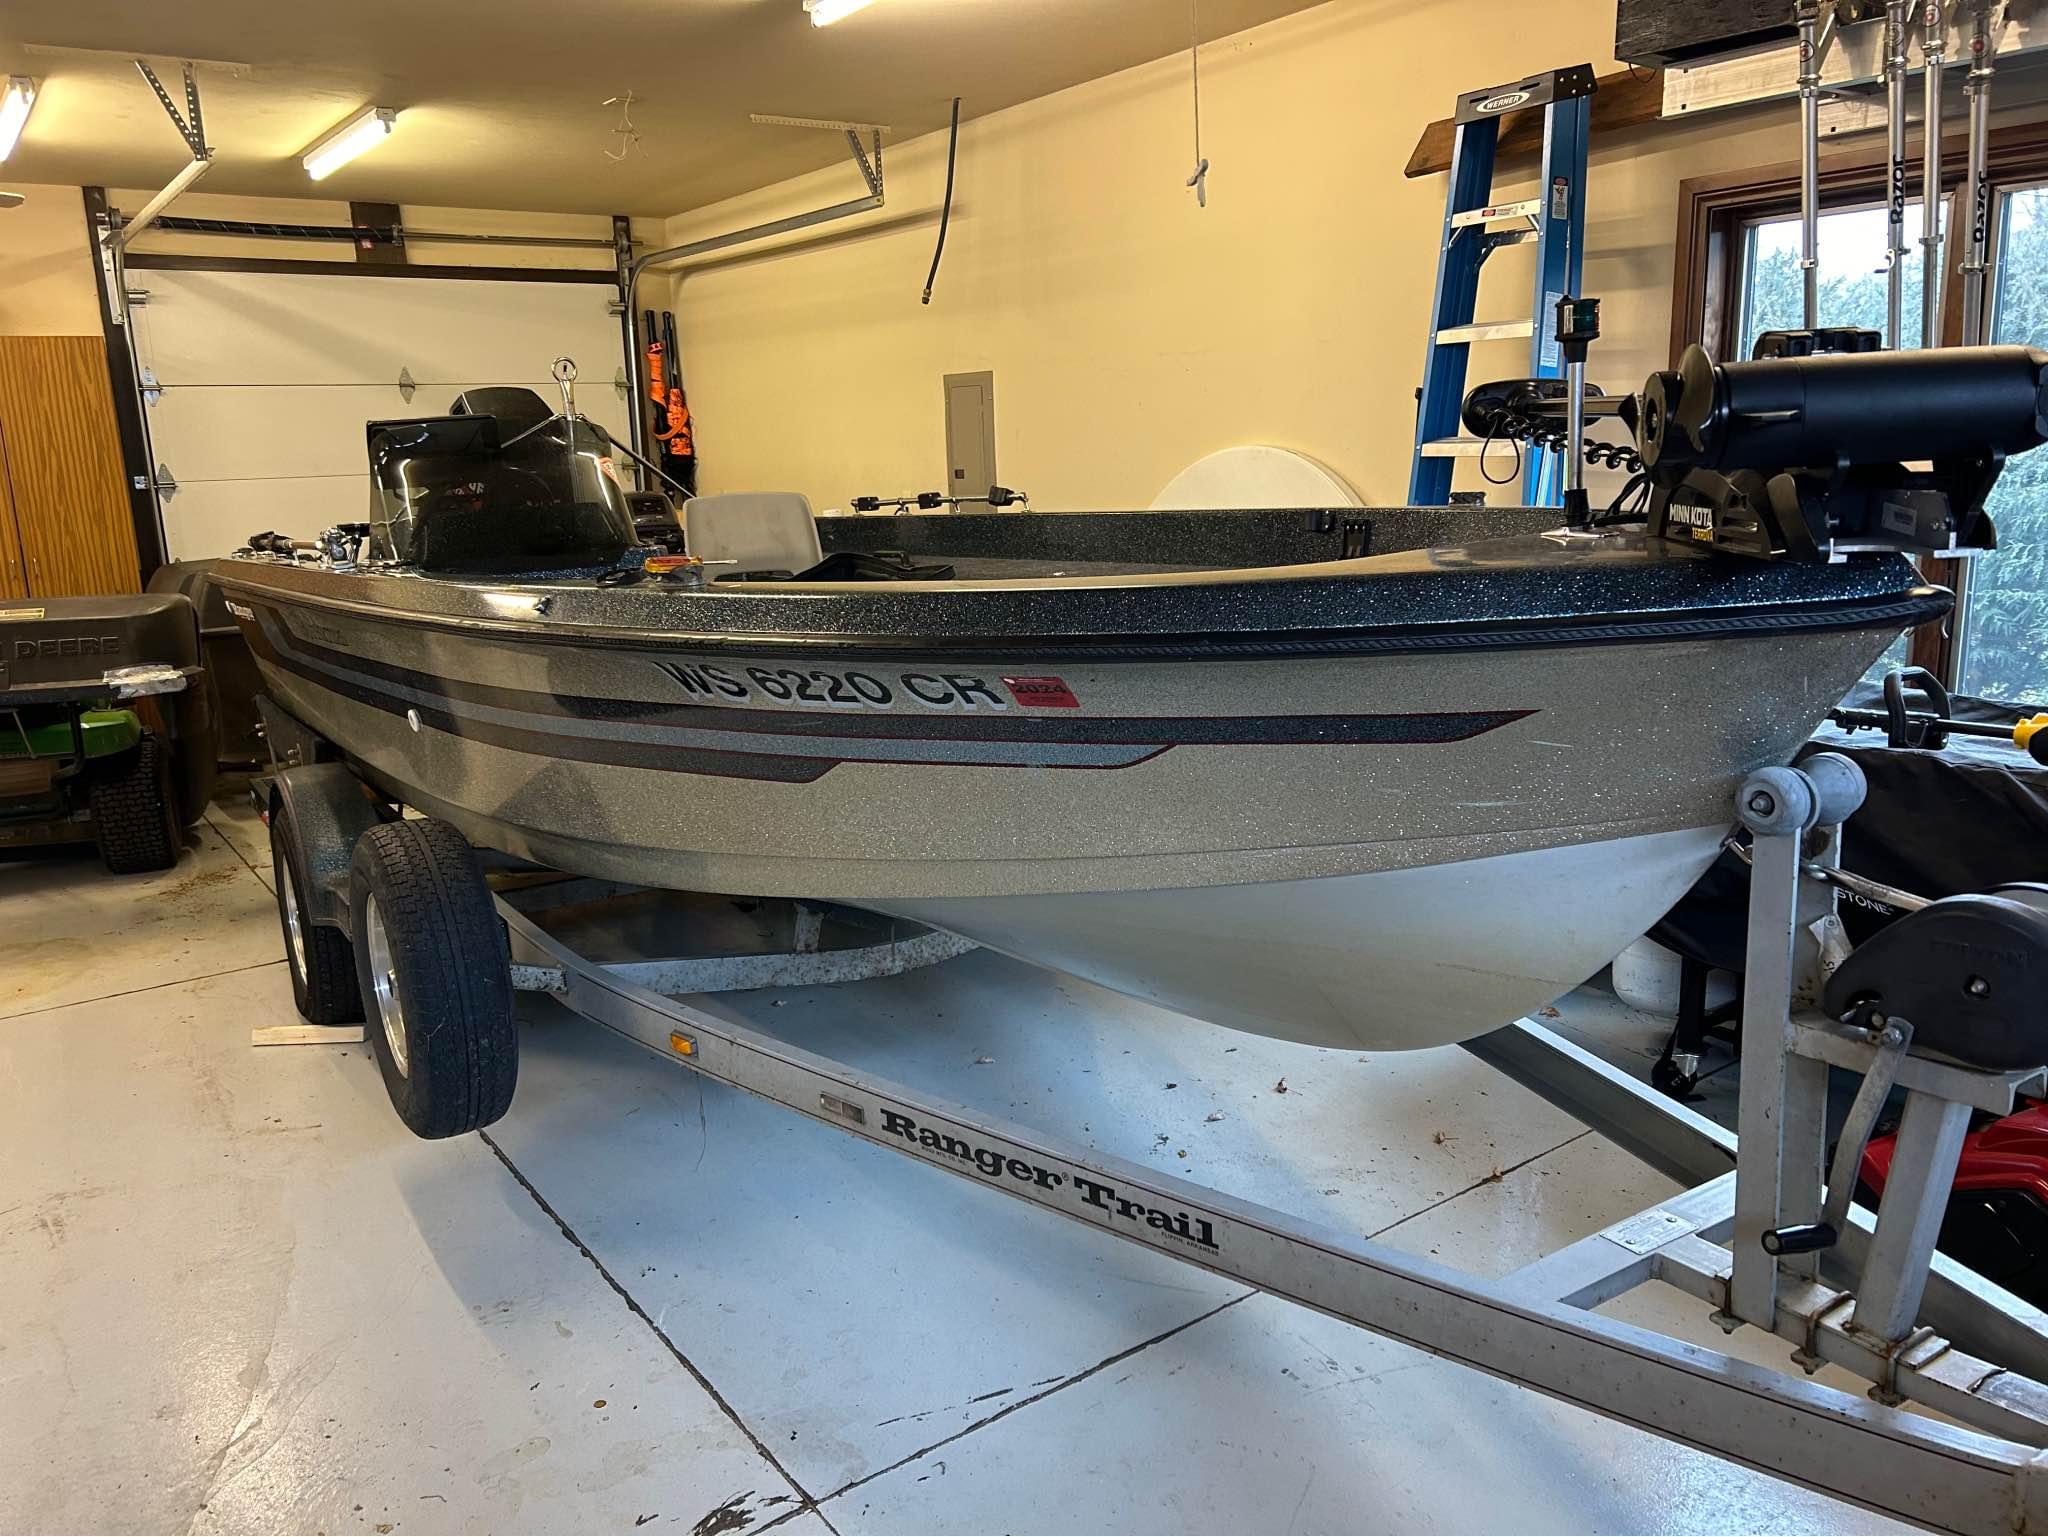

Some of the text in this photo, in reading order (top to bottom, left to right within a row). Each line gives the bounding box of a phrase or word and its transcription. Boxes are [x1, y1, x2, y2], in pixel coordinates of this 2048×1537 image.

[1486, 95, 1520, 109] WERNER
[1891, 154, 1905, 225] Razor
[1669, 503, 1713, 528] MINN KOTA
[15, 636, 121, 658] DEERE
[651, 660, 1006, 709] WS 6220 CR
[1074, 1175, 1219, 1249] Trail
